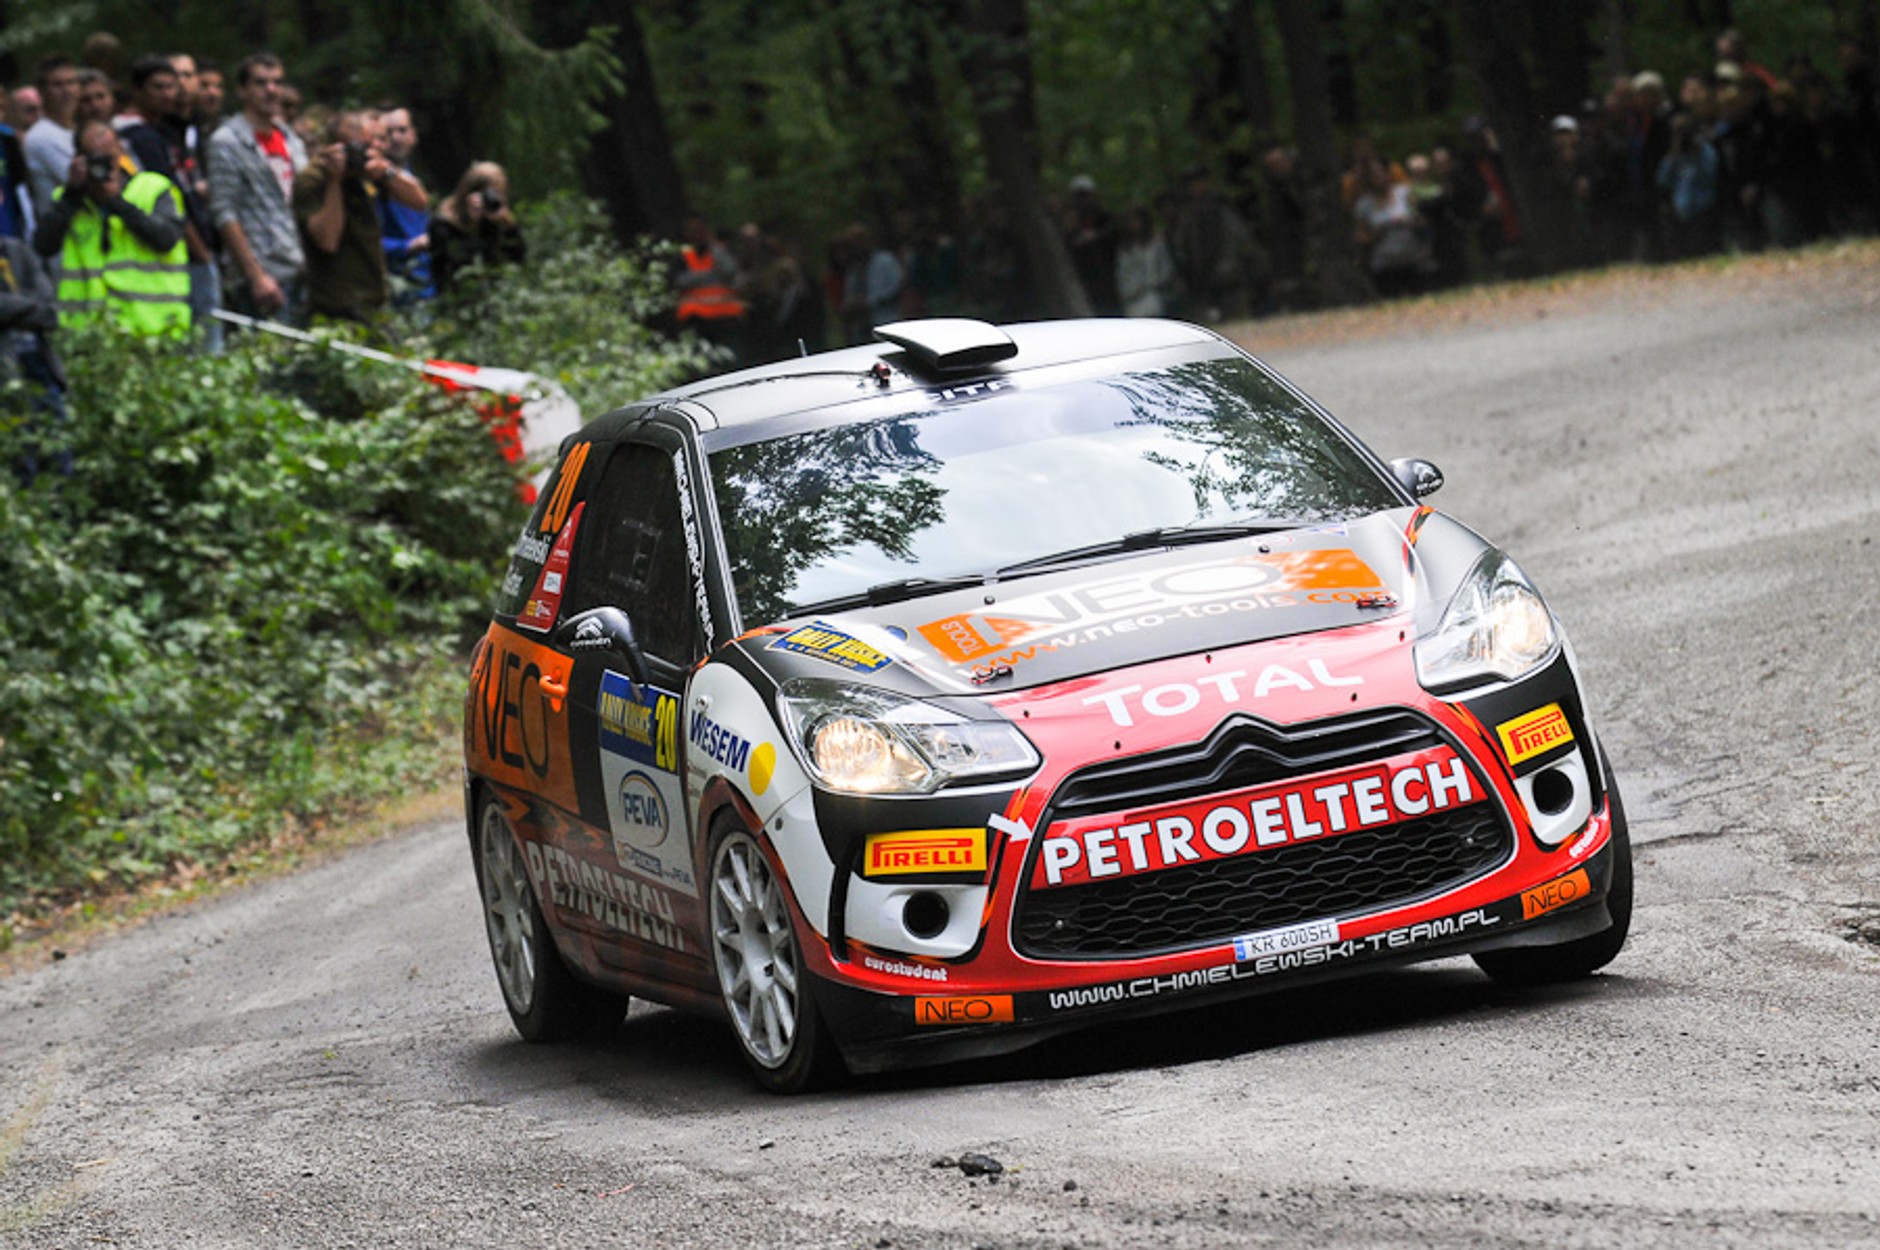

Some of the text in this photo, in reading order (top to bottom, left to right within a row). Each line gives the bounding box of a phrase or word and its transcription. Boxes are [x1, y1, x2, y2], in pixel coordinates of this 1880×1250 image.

[540, 441, 591, 533] 20
[966, 562, 1284, 647] NEO
[471, 642, 549, 779] NEO
[1083, 659, 1363, 727] TOTAL
[655, 694, 677, 772] 20
[690, 709, 751, 773] WESEM
[1508, 711, 1569, 755] PIRELLI
[624, 791, 663, 829] PEVA
[1042, 757, 1472, 885] PETROELTECH
[872, 838, 973, 868] PIRELLI
[1528, 878, 1577, 914] NEO
[864, 955, 947, 981] eurostudent
[1050, 910, 1499, 1009] WWW.CHMIELEWSKI-TEAM.PL
[1251, 938, 1276, 954] KR
[925, 999, 993, 1021] NEO
